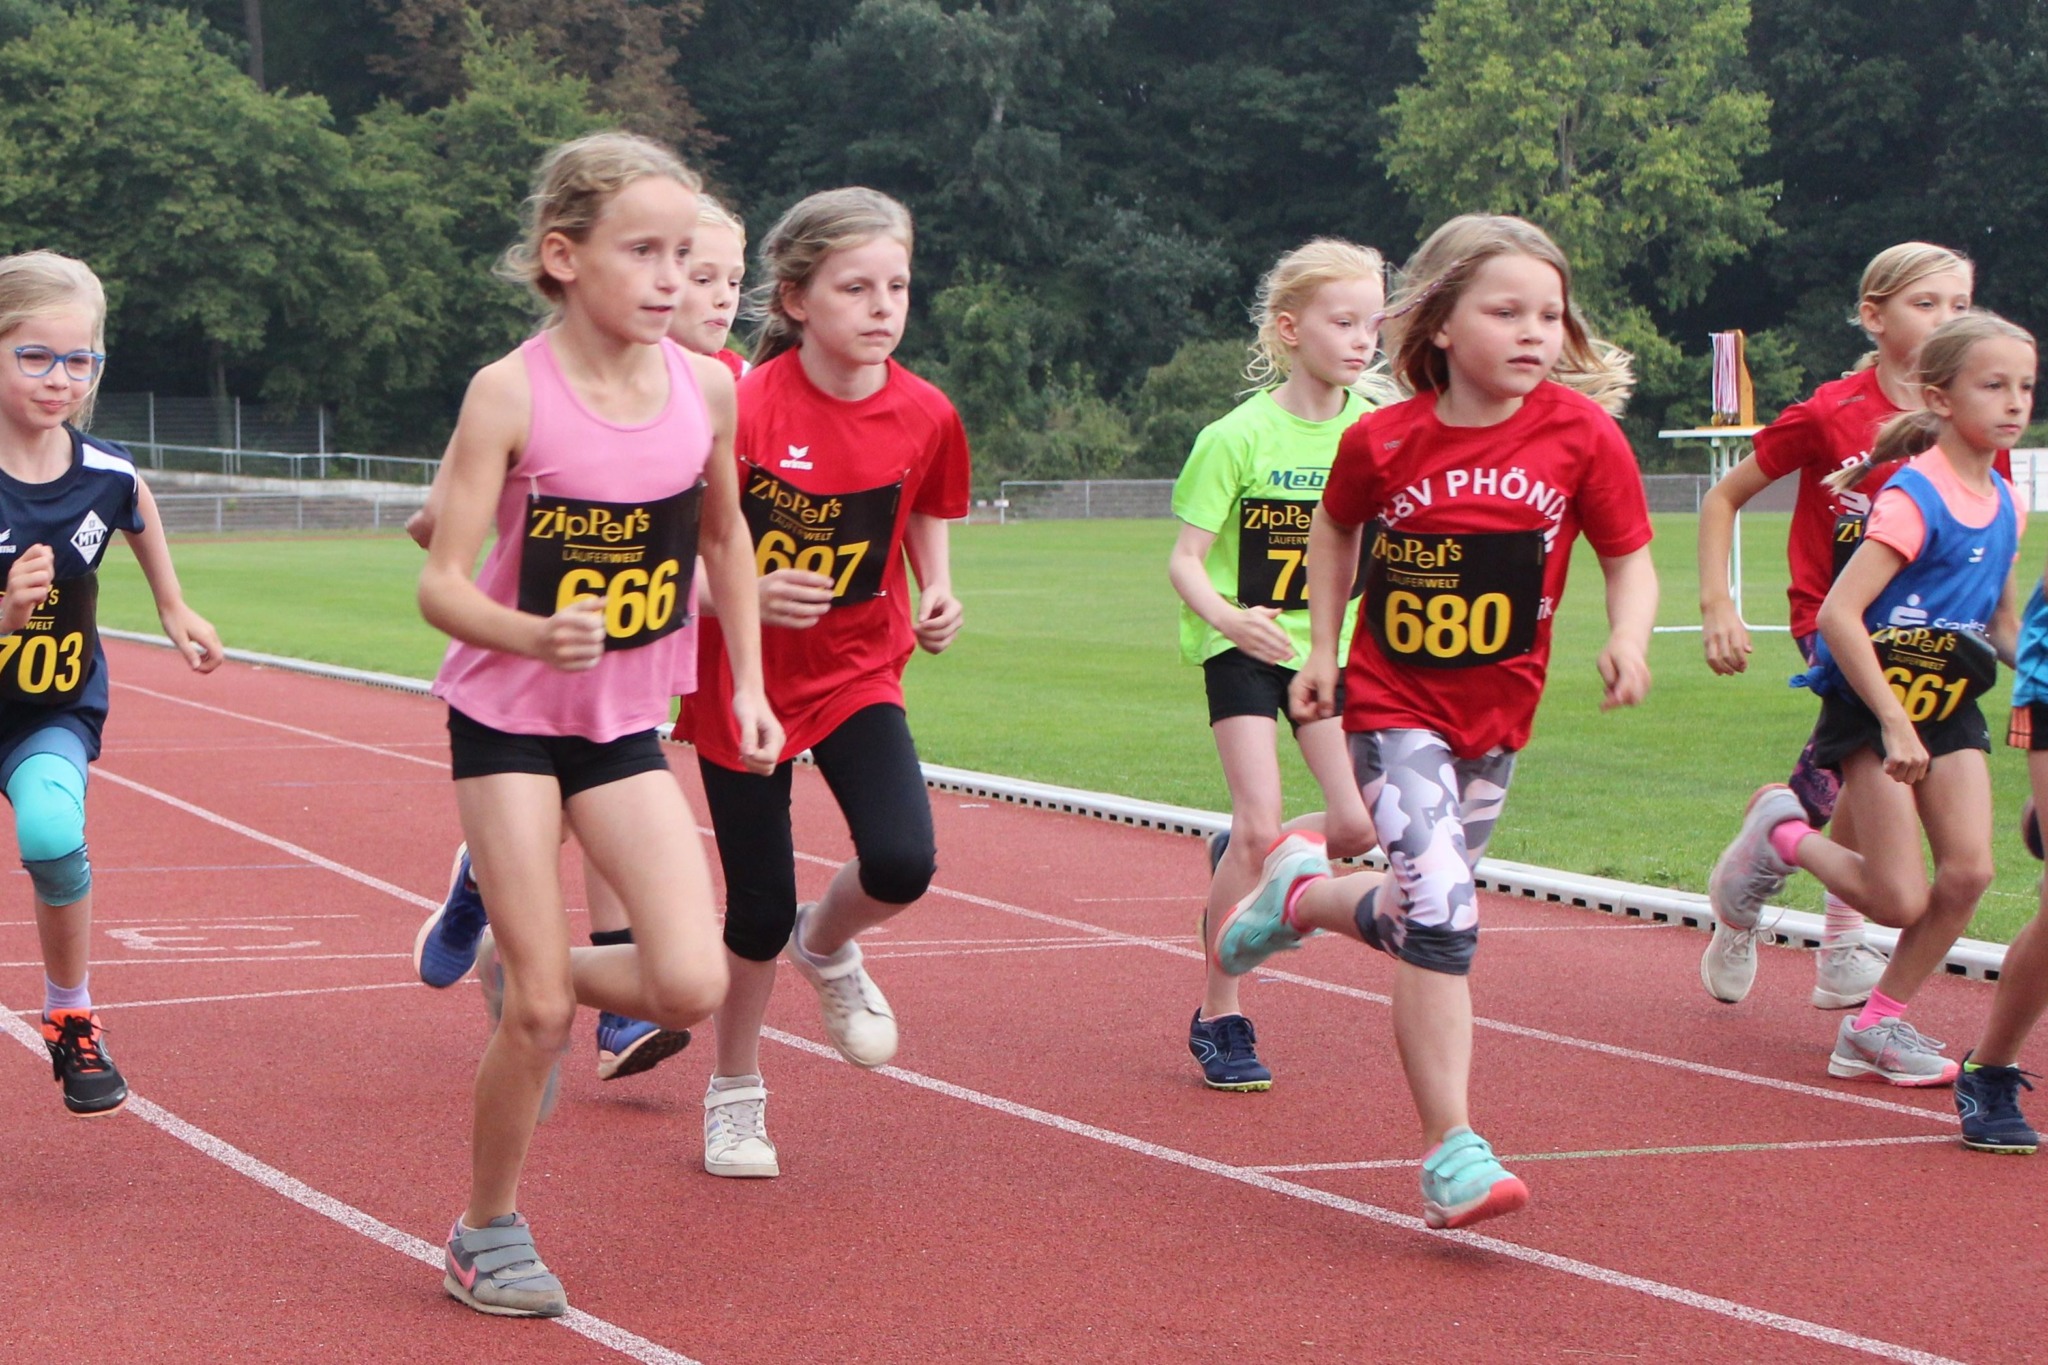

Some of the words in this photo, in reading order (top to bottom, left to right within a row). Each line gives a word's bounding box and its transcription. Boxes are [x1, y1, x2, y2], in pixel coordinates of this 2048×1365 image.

[1267, 470, 1325, 491] Meb
[78, 529, 105, 547] MTV
[529, 506, 650, 542] ZipPel's
[555, 559, 679, 638] 666
[1385, 590, 1512, 658] 680
[0, 632, 84, 695] 703
